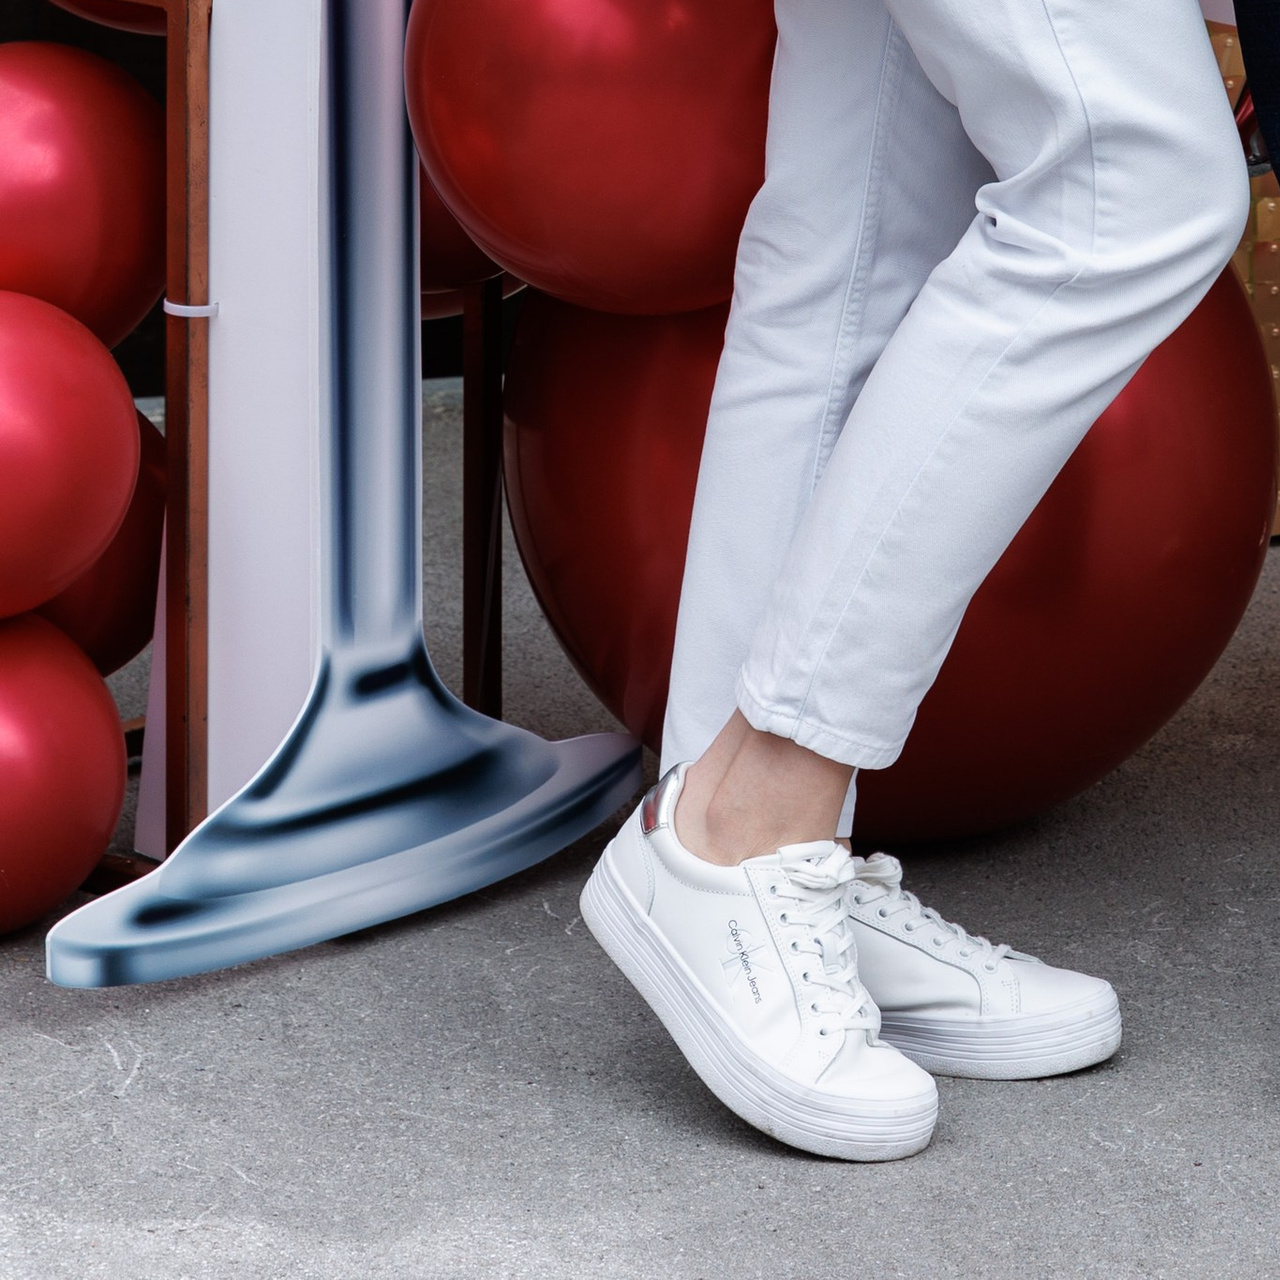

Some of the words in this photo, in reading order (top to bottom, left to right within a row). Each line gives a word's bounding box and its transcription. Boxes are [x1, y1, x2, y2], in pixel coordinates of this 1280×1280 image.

[728, 919, 744, 951] Calvin
[739, 950, 752, 975] Klein
[747, 975, 762, 1005] Jeans
